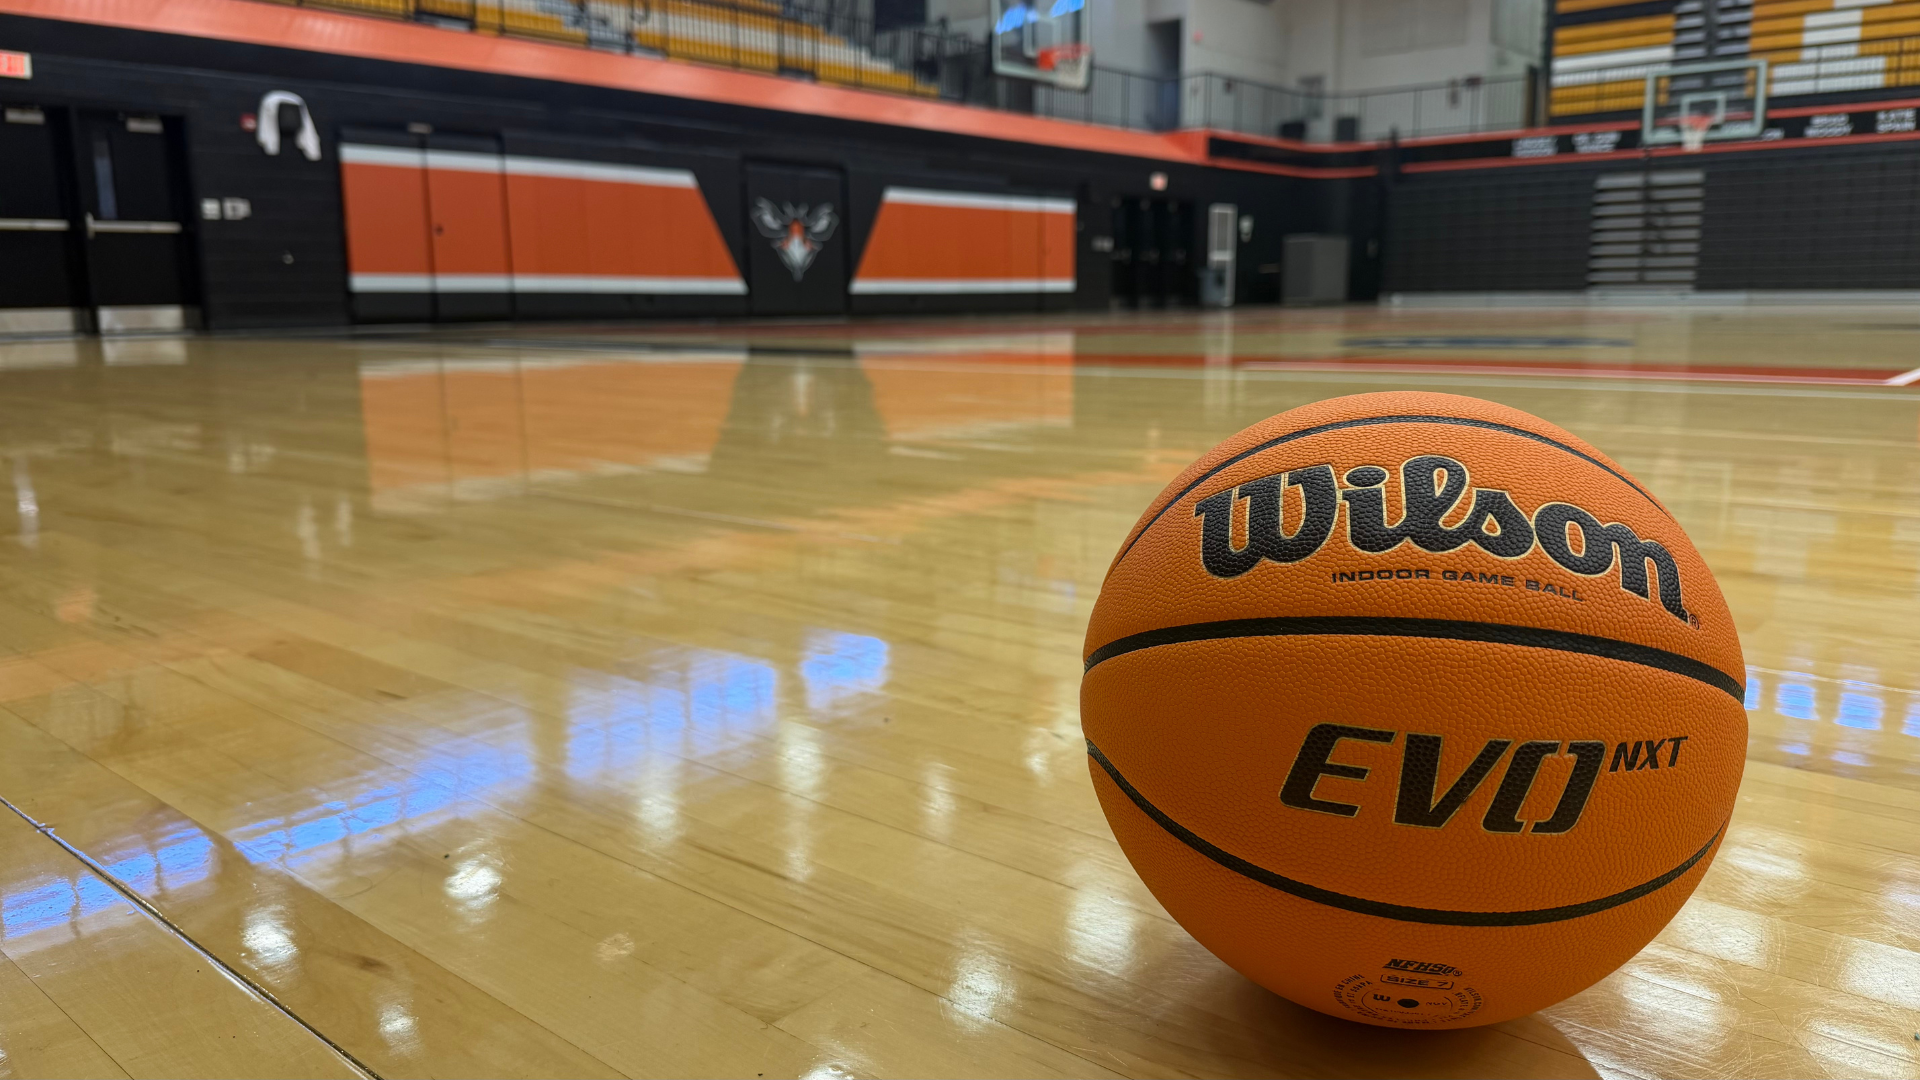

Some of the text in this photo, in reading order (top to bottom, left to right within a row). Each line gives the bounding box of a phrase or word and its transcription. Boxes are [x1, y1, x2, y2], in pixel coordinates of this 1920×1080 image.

[1331, 568, 1584, 602] INDOOR GAME BALL
[1278, 721, 1689, 834] EVO NXT
[1387, 976, 1429, 986] SIZE
